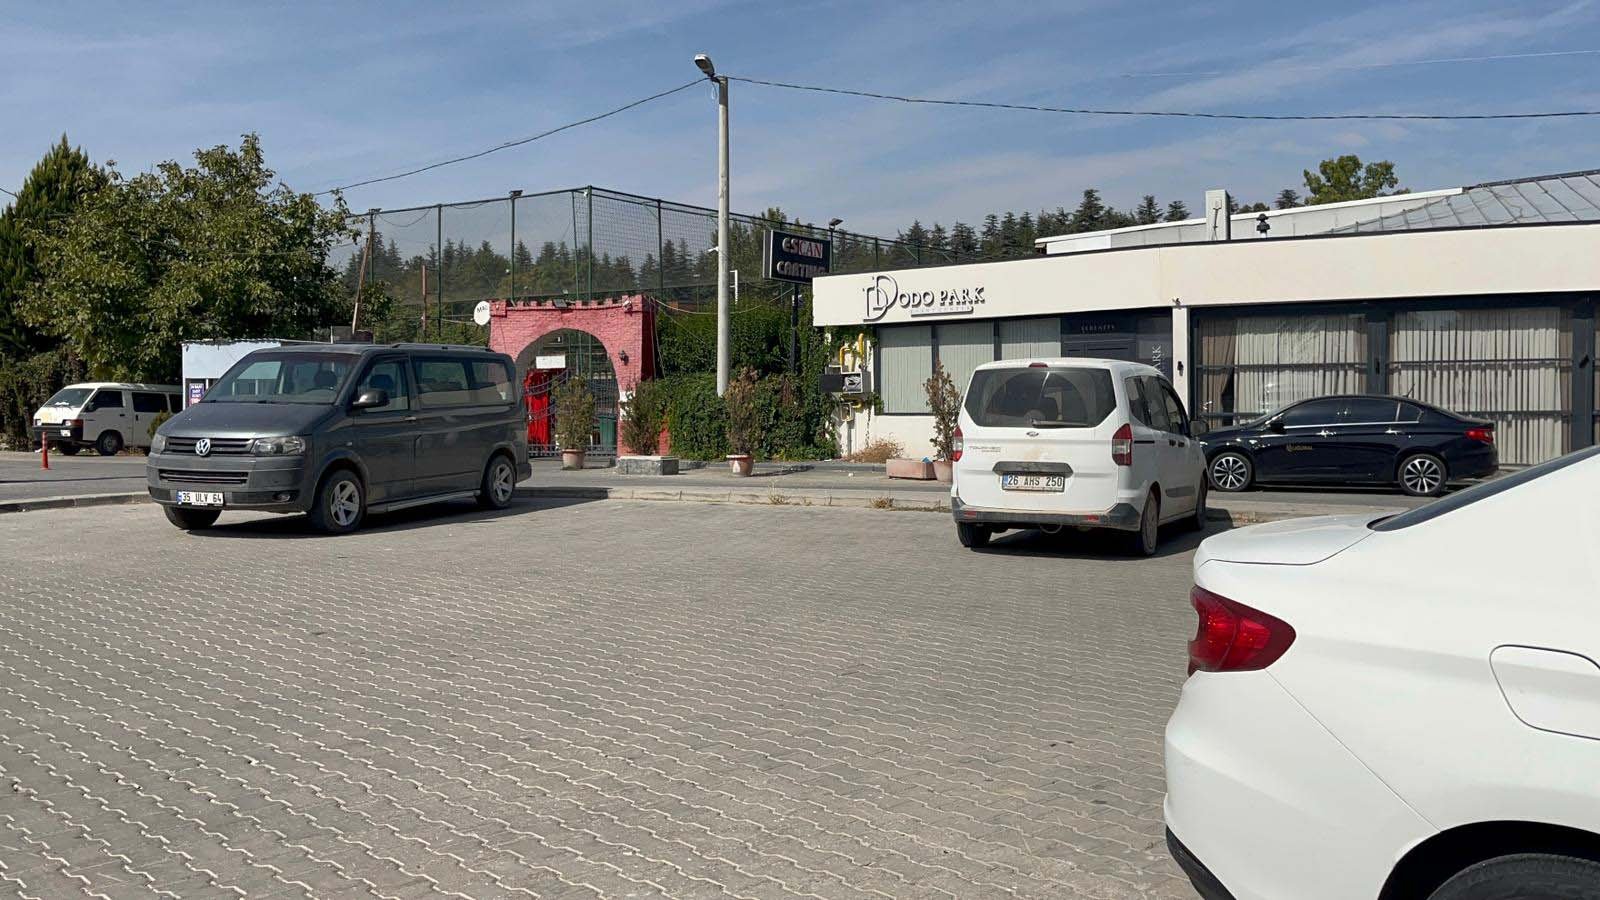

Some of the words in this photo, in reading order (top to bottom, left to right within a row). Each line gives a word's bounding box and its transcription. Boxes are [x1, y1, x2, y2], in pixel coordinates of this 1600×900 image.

[940, 286, 986, 307] PARK
[1152, 344, 1162, 371] ARK
[1008, 475, 1019, 486] 26
[1046, 477, 1063, 487] 250
[182, 492, 191, 502] 35
[212, 494, 222, 503] 64
